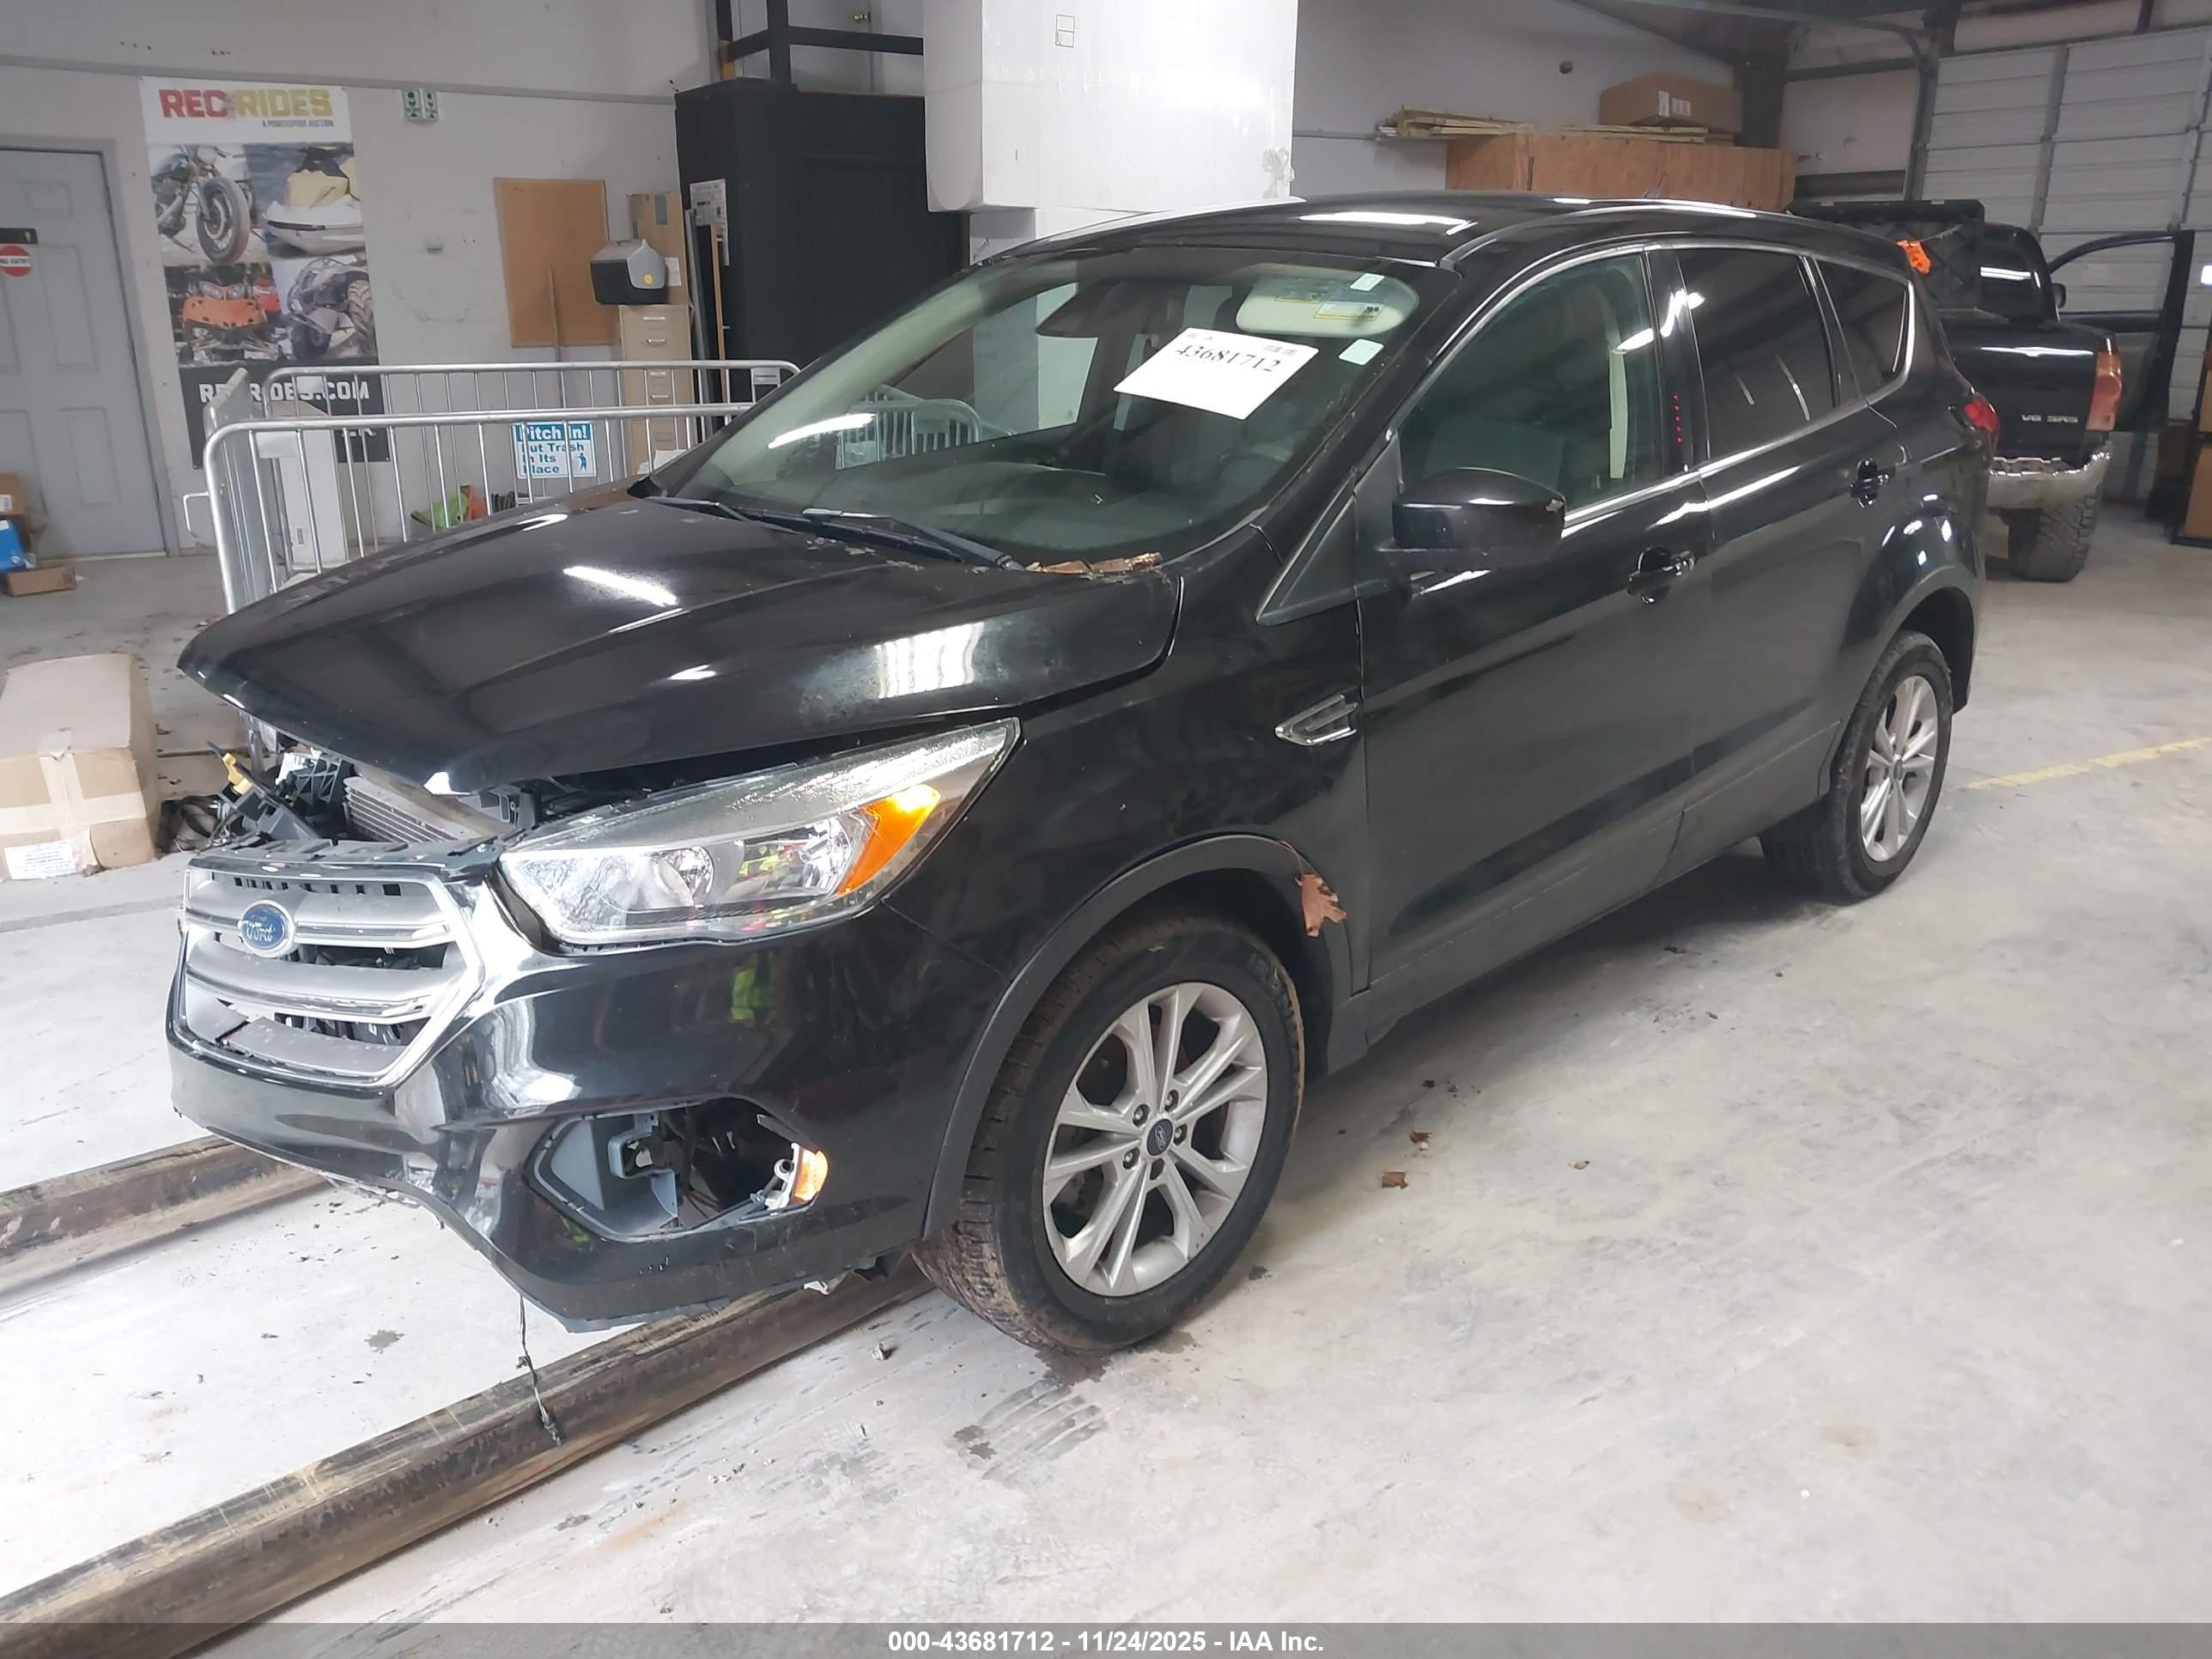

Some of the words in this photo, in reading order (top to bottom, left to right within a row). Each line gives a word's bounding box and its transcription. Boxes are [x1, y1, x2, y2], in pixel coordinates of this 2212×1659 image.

[159, 88, 228, 118] REC
[234, 88, 332, 117] RIDES
[1176, 344, 1282, 372] 43681712
[539, 453, 556, 463] Its
